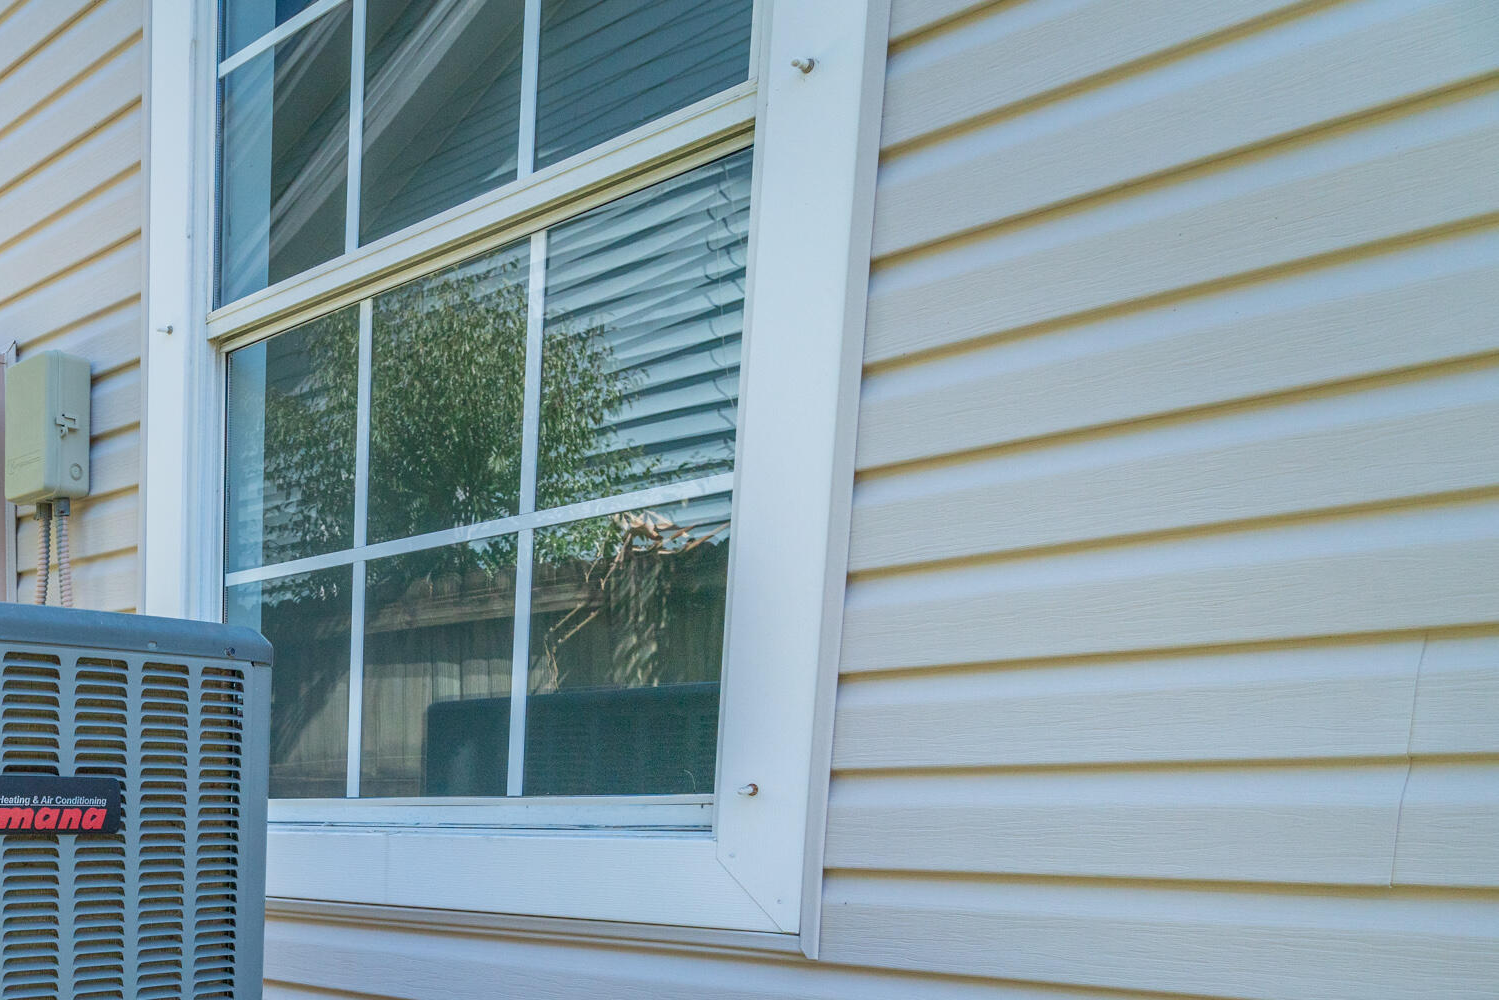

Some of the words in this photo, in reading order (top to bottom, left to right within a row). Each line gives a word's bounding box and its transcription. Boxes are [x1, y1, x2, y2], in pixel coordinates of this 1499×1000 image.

[32, 795, 40, 804] &
[41, 796, 54, 804] Air
[55, 795, 107, 807] Conditioning
